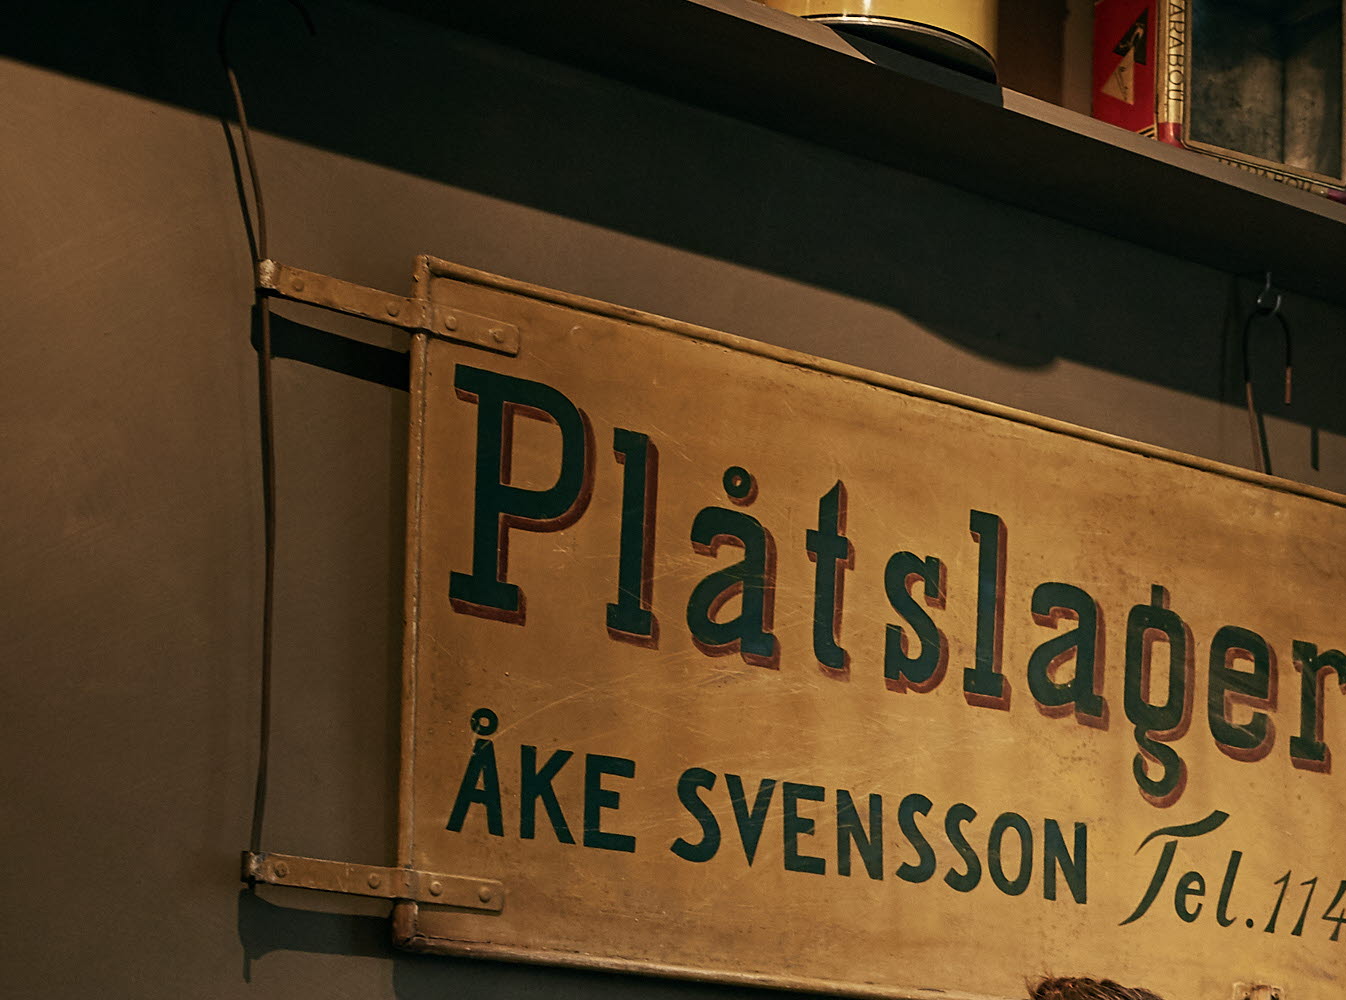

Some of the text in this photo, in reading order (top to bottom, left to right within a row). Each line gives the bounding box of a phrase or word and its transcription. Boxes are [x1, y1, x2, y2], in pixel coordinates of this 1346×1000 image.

[1167, 2, 1185, 101] ARABOU
[446, 707, 637, 854] ÅKE
[670, 766, 1089, 906] SVENSSON
